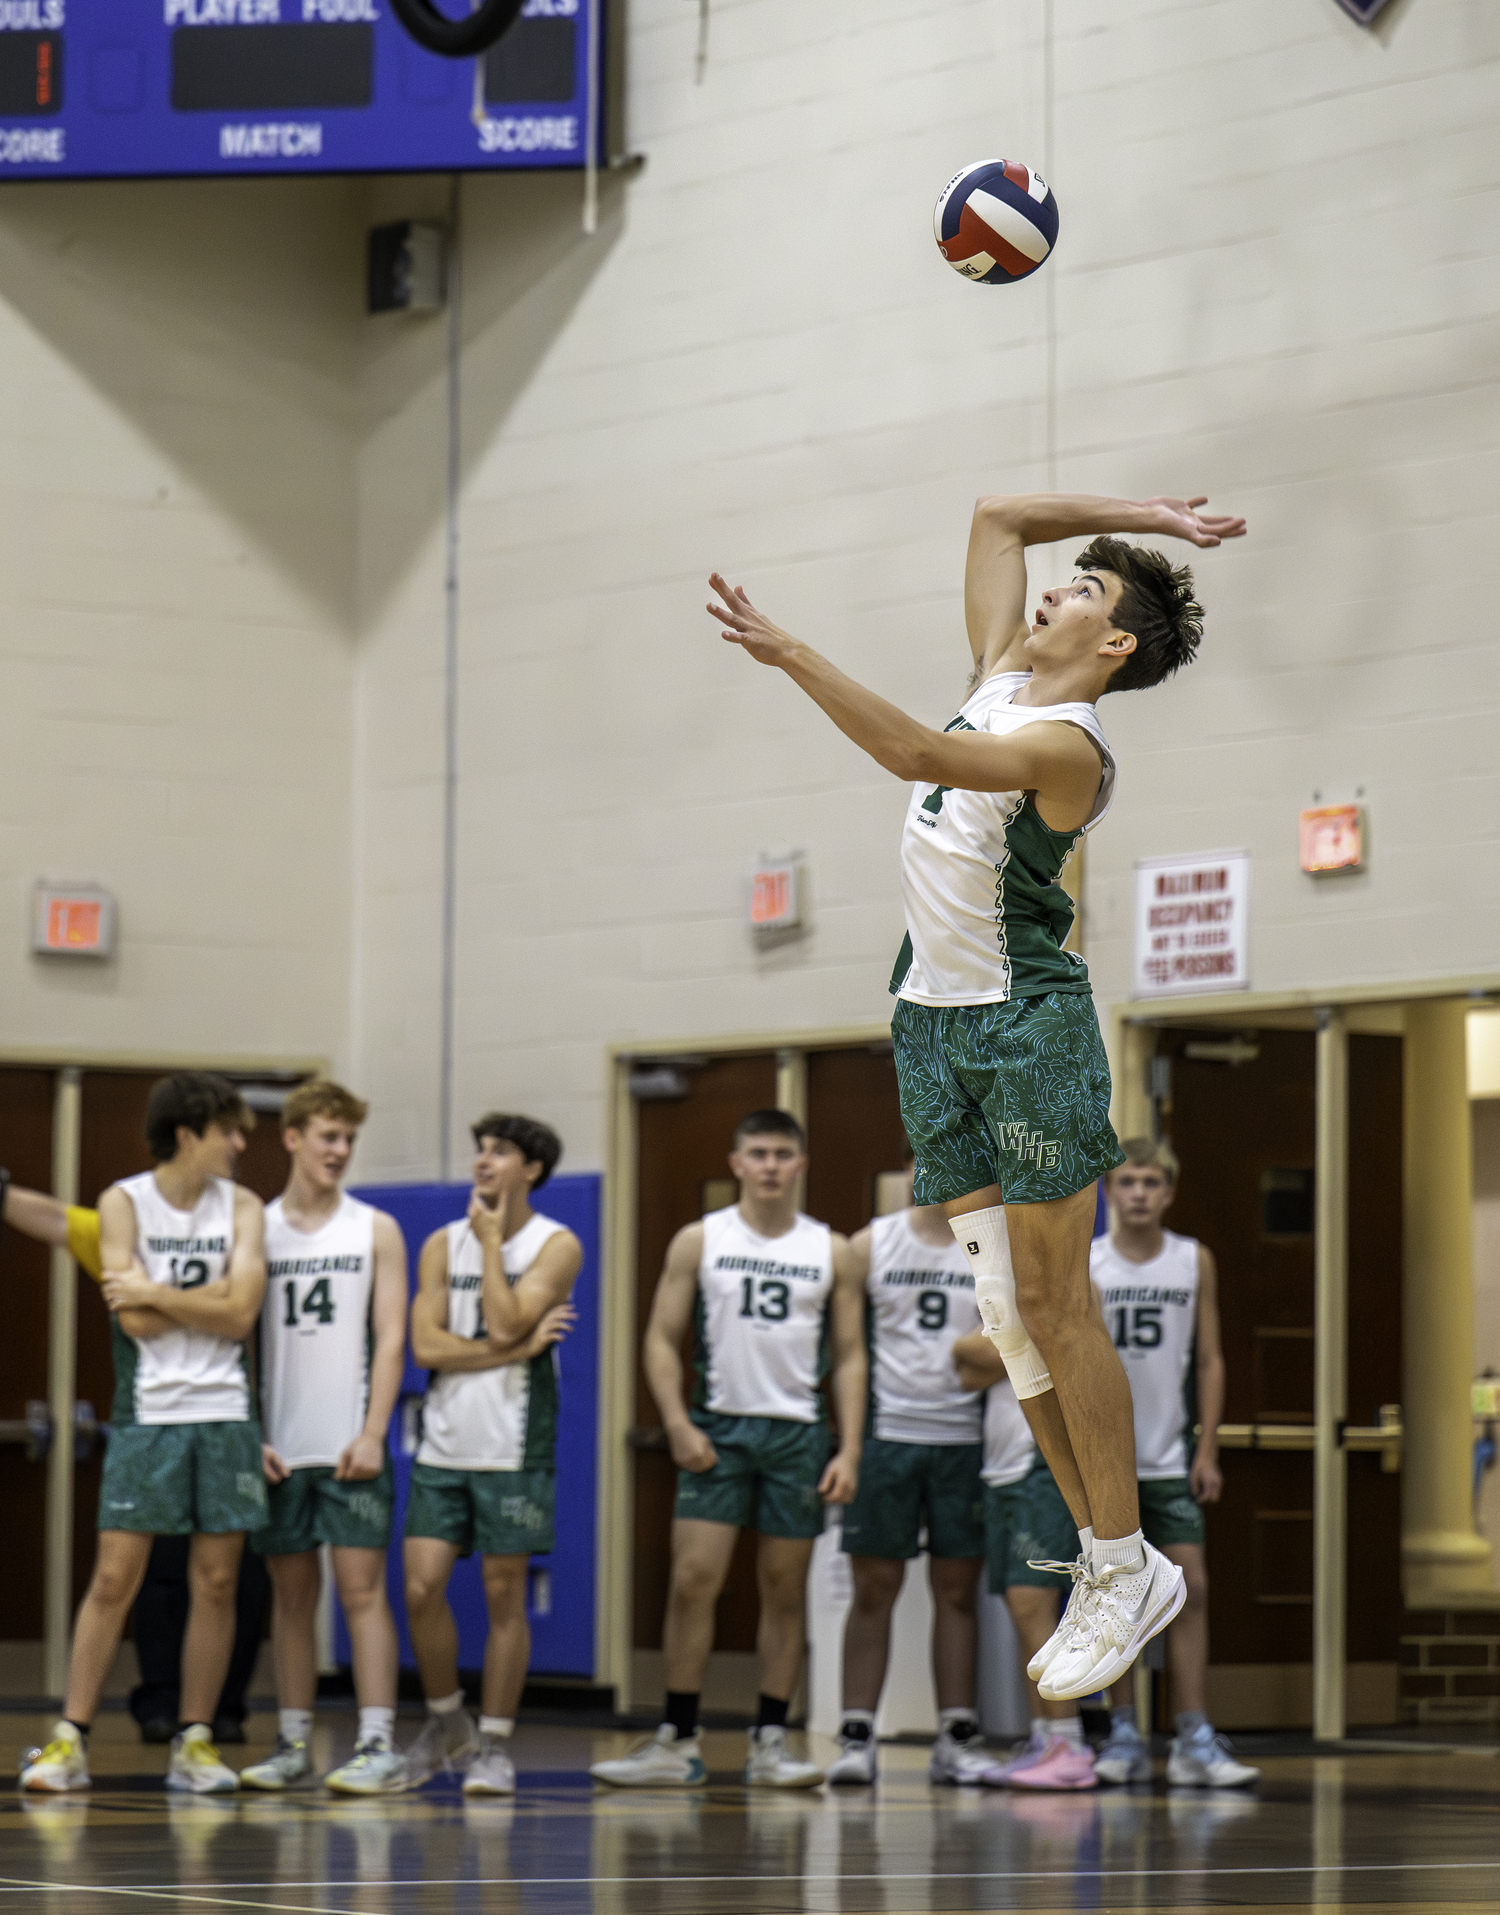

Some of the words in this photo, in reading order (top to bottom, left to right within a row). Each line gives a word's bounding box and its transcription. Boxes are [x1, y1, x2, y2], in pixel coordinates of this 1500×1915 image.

[220, 121, 322, 159] MATCH
[478, 116, 578, 152] SCORE
[997, 1121, 1062, 1171] WHB
[714, 1254, 820, 1282] HURRICANES
[284, 1277, 335, 1327] 14
[740, 1276, 789, 1321] 13
[918, 1290, 947, 1330] 9
[1114, 1306, 1163, 1350] 15
